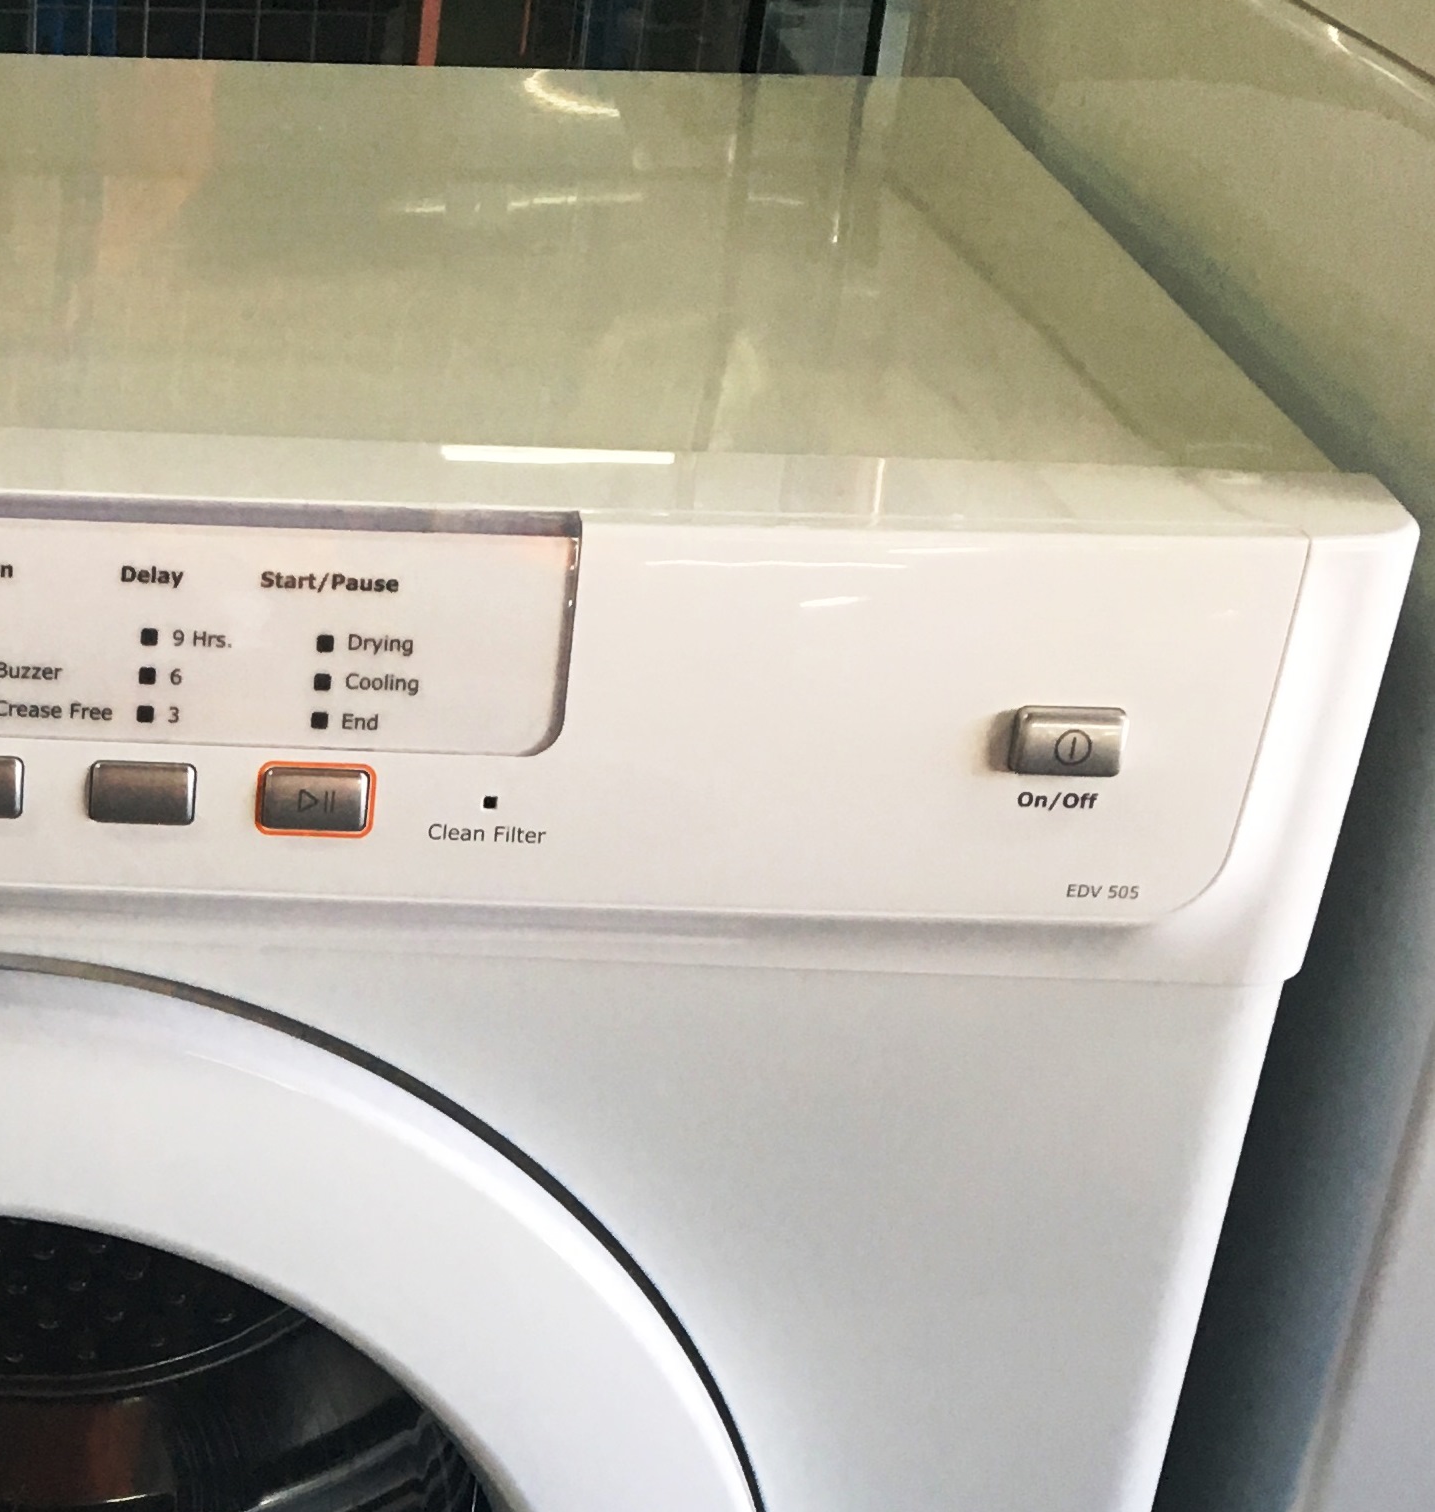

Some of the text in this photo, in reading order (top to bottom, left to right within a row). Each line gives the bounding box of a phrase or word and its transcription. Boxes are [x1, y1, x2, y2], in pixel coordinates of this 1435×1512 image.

[121, 566, 184, 588] Delay
[261, 571, 400, 593] Start/Pause
[172, 630, 232, 649] 9 Hrs.
[348, 635, 414, 656] Drying
[170, 669, 182, 686] 6
[346, 674, 419, 696] Cooling
[69, 704, 113, 721] Free
[168, 707, 179, 723] 3
[342, 713, 379, 731] End
[1017, 791, 1099, 811] On/Off
[428, 823, 546, 844] Clean Filter
[1066, 884, 1139, 899] EDV 505
